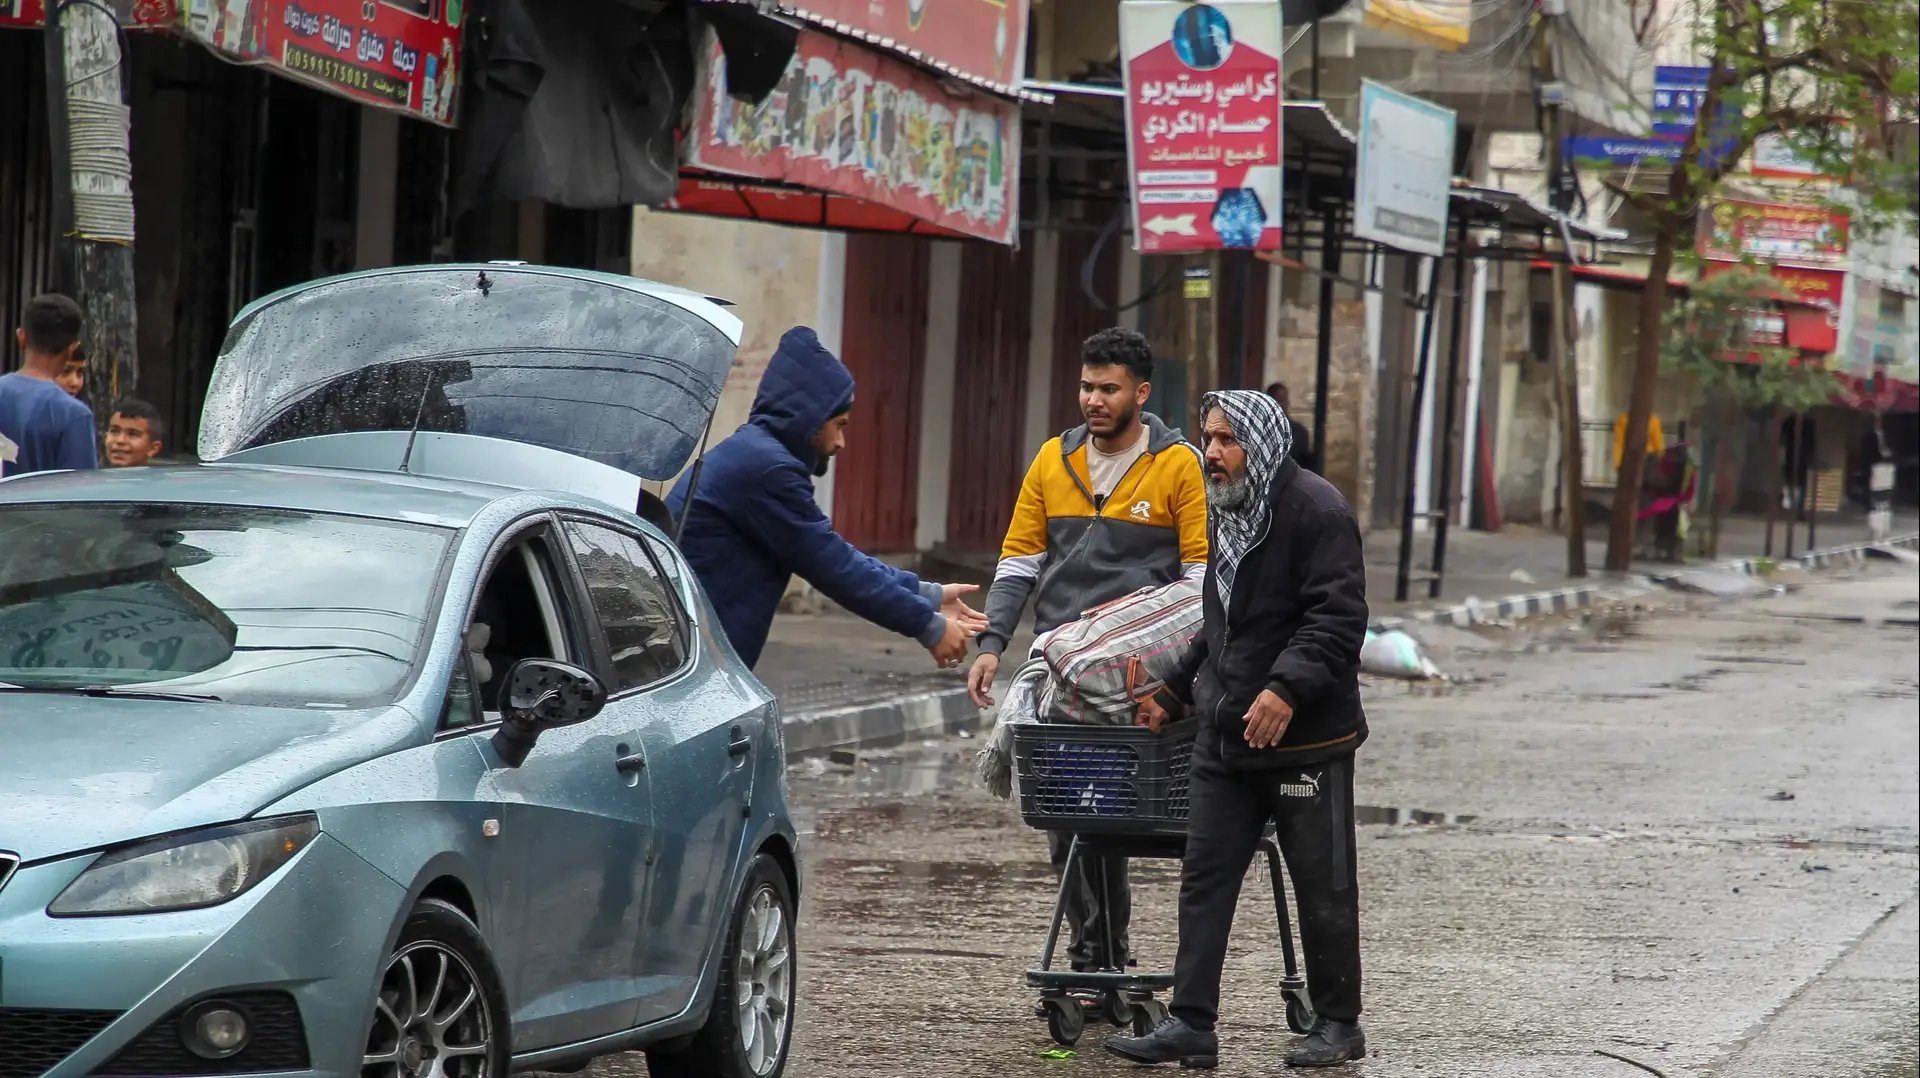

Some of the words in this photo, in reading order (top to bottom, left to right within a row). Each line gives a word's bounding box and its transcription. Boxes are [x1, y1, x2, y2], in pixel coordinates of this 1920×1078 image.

[322, 15, 351, 52] صرافة
[357, 29, 384, 62] مفرق
[392, 40, 416, 76] جملة
[1140, 74, 1214, 106] وستيريو
[1216, 72, 1277, 107] كراسي
[1141, 110, 1205, 143] الكردي
[1207, 111, 1272, 138] حسام
[1149, 146, 1221, 164] المناسبات
[1223, 143, 1267, 166] لجميع
[1280, 784, 1314, 797] PUMA
